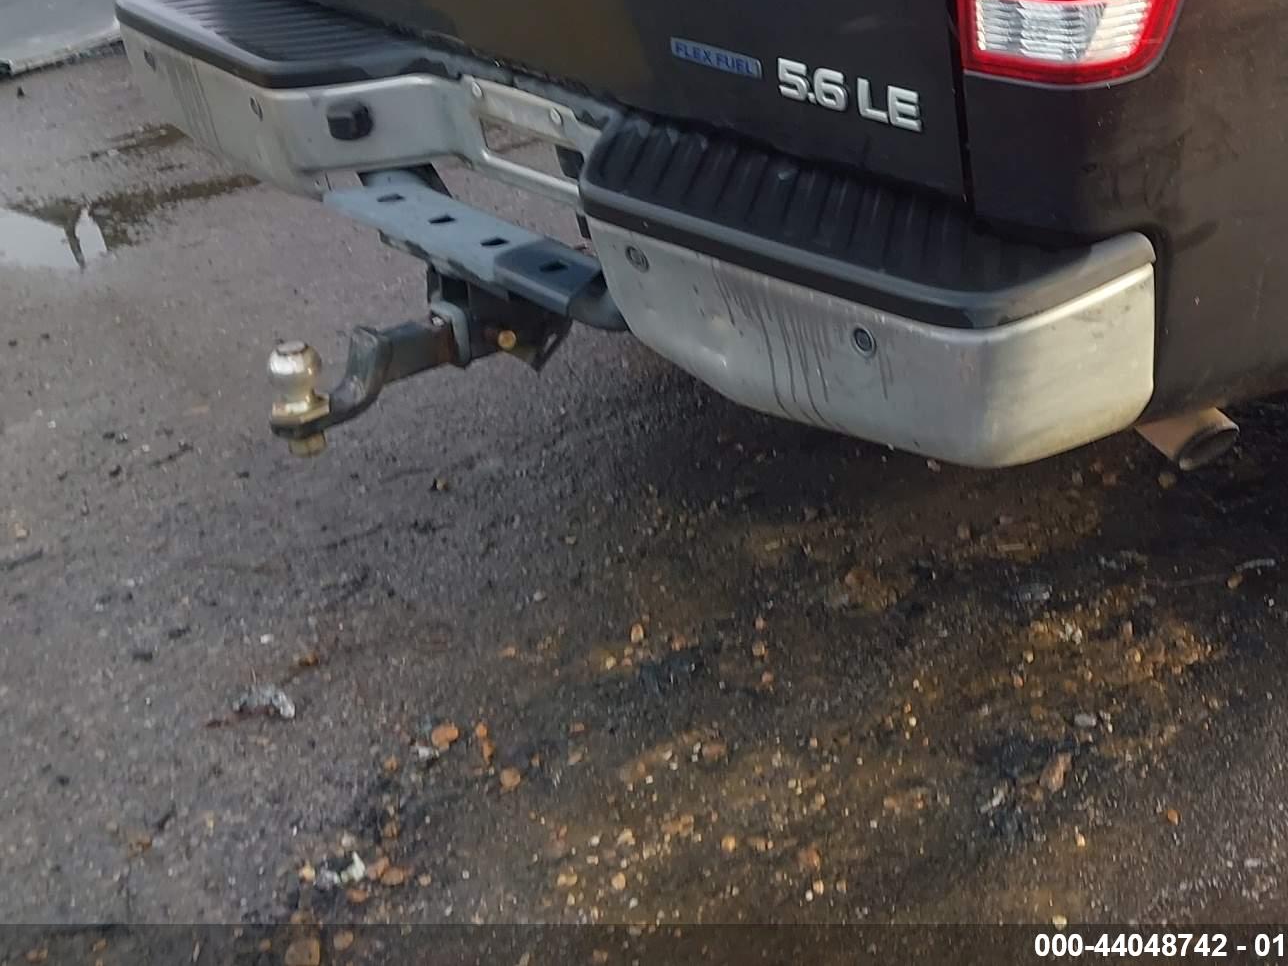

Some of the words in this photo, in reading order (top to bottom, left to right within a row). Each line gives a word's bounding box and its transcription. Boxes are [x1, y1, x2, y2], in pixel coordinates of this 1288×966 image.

[674, 40, 712, 65] FLEX
[716, 52, 753, 75] FUEL
[777, 56, 848, 112] 5.6
[857, 77, 922, 132] LE
